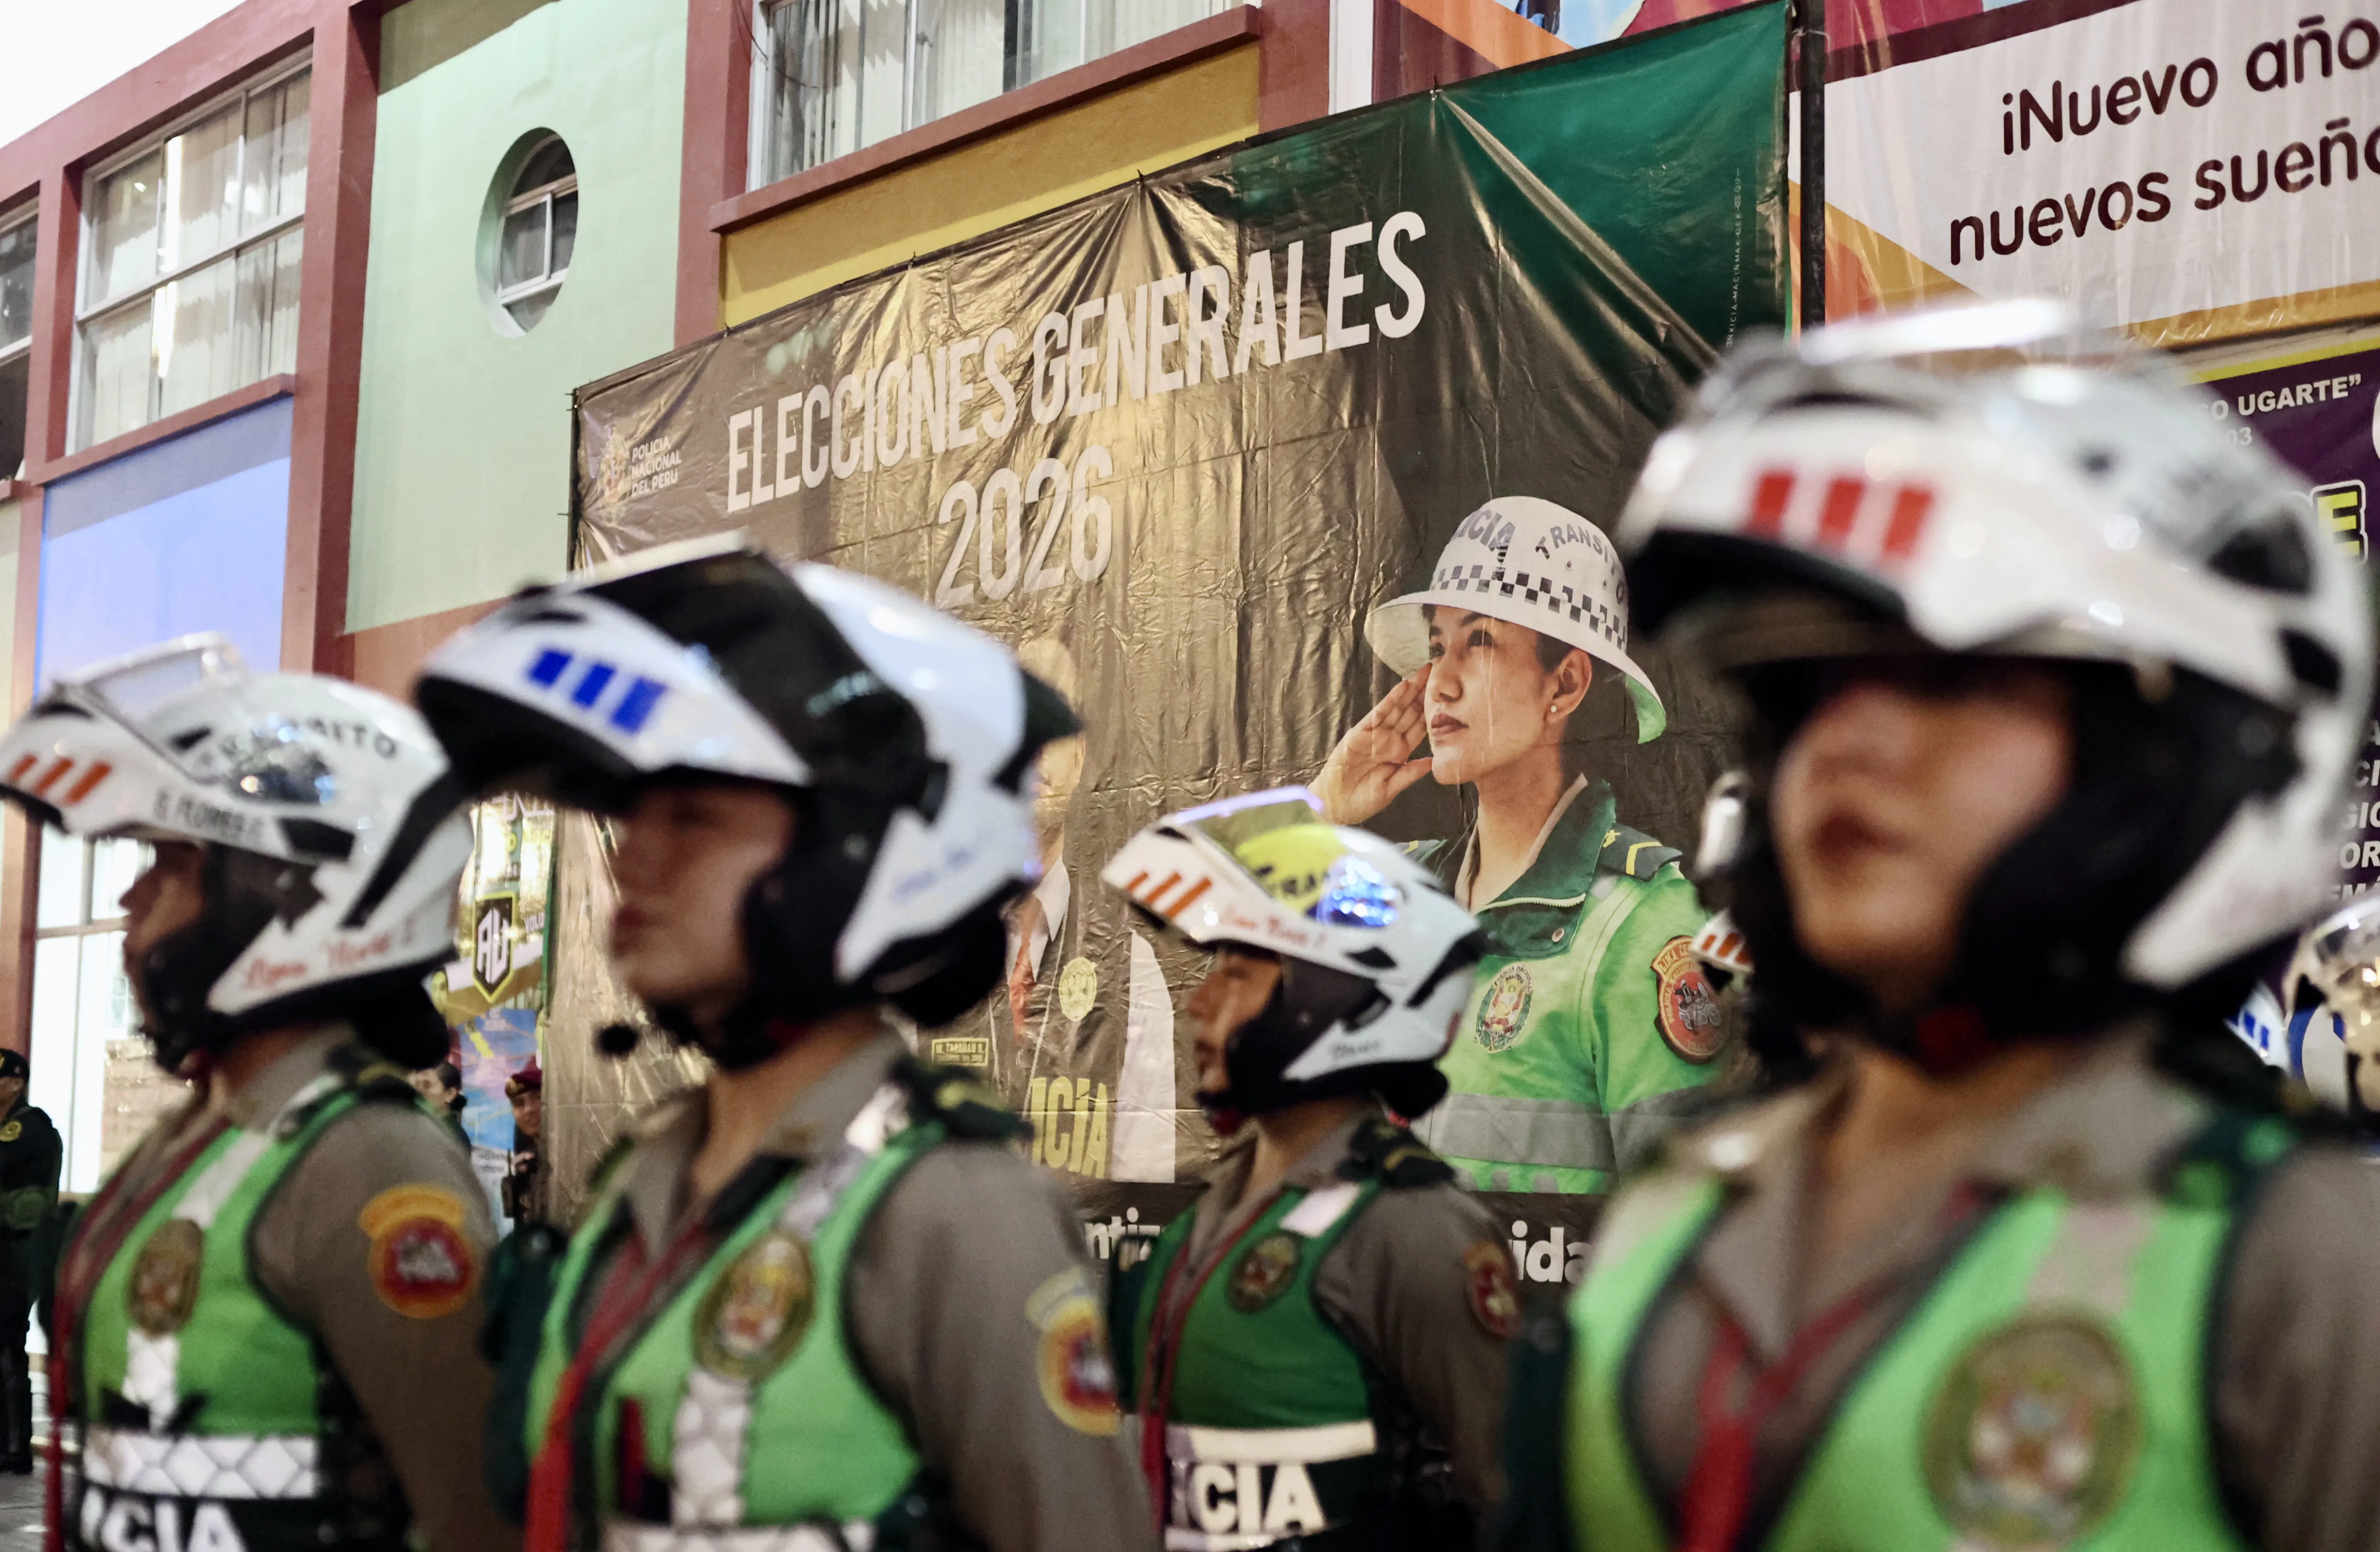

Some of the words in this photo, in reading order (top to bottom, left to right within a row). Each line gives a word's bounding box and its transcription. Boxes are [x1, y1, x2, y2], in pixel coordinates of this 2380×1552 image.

[1950, 172, 2171, 265] nuevos
[727, 327, 1017, 513] ELECCIONES
[1031, 211, 1426, 425] GENERALES
[631, 450, 682, 479] NACIONAL
[631, 479, 651, 497] DEL
[632, 435, 671, 462] POLICIA
[935, 444, 1113, 610] 2026
[1535, 523, 1625, 605] TRANSITO
